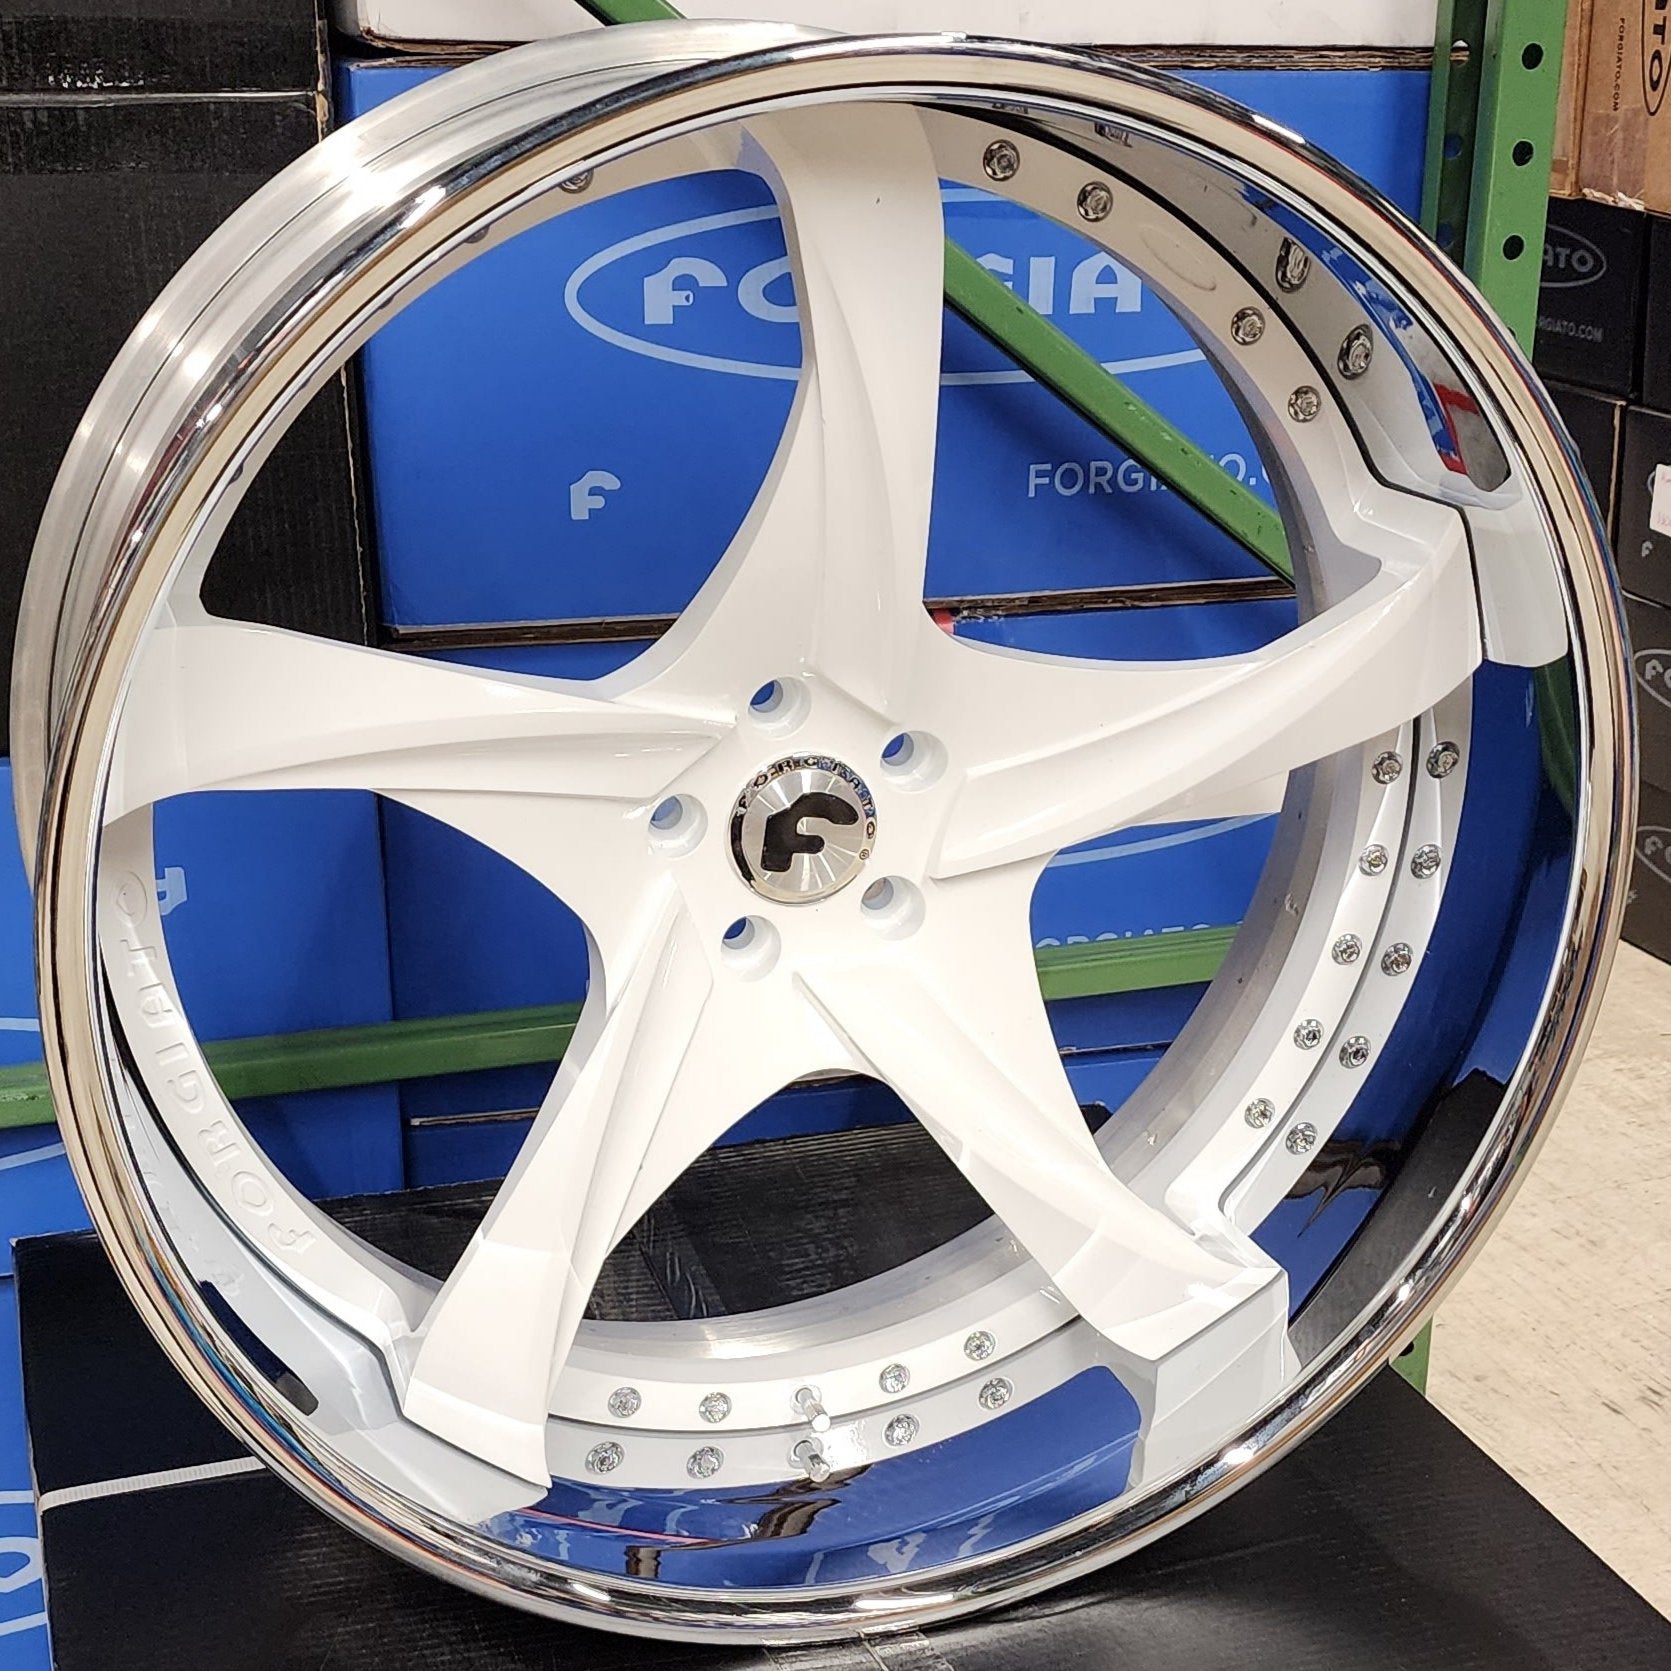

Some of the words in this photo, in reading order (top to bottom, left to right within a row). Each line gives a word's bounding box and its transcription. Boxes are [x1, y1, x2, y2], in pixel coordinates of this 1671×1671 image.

[1612, 17, 1626, 112] FORGIATO.COM
[568, 470, 621, 520] F
[760, 792, 859, 873] F
[114, 870, 316, 1255] FORGIATO
